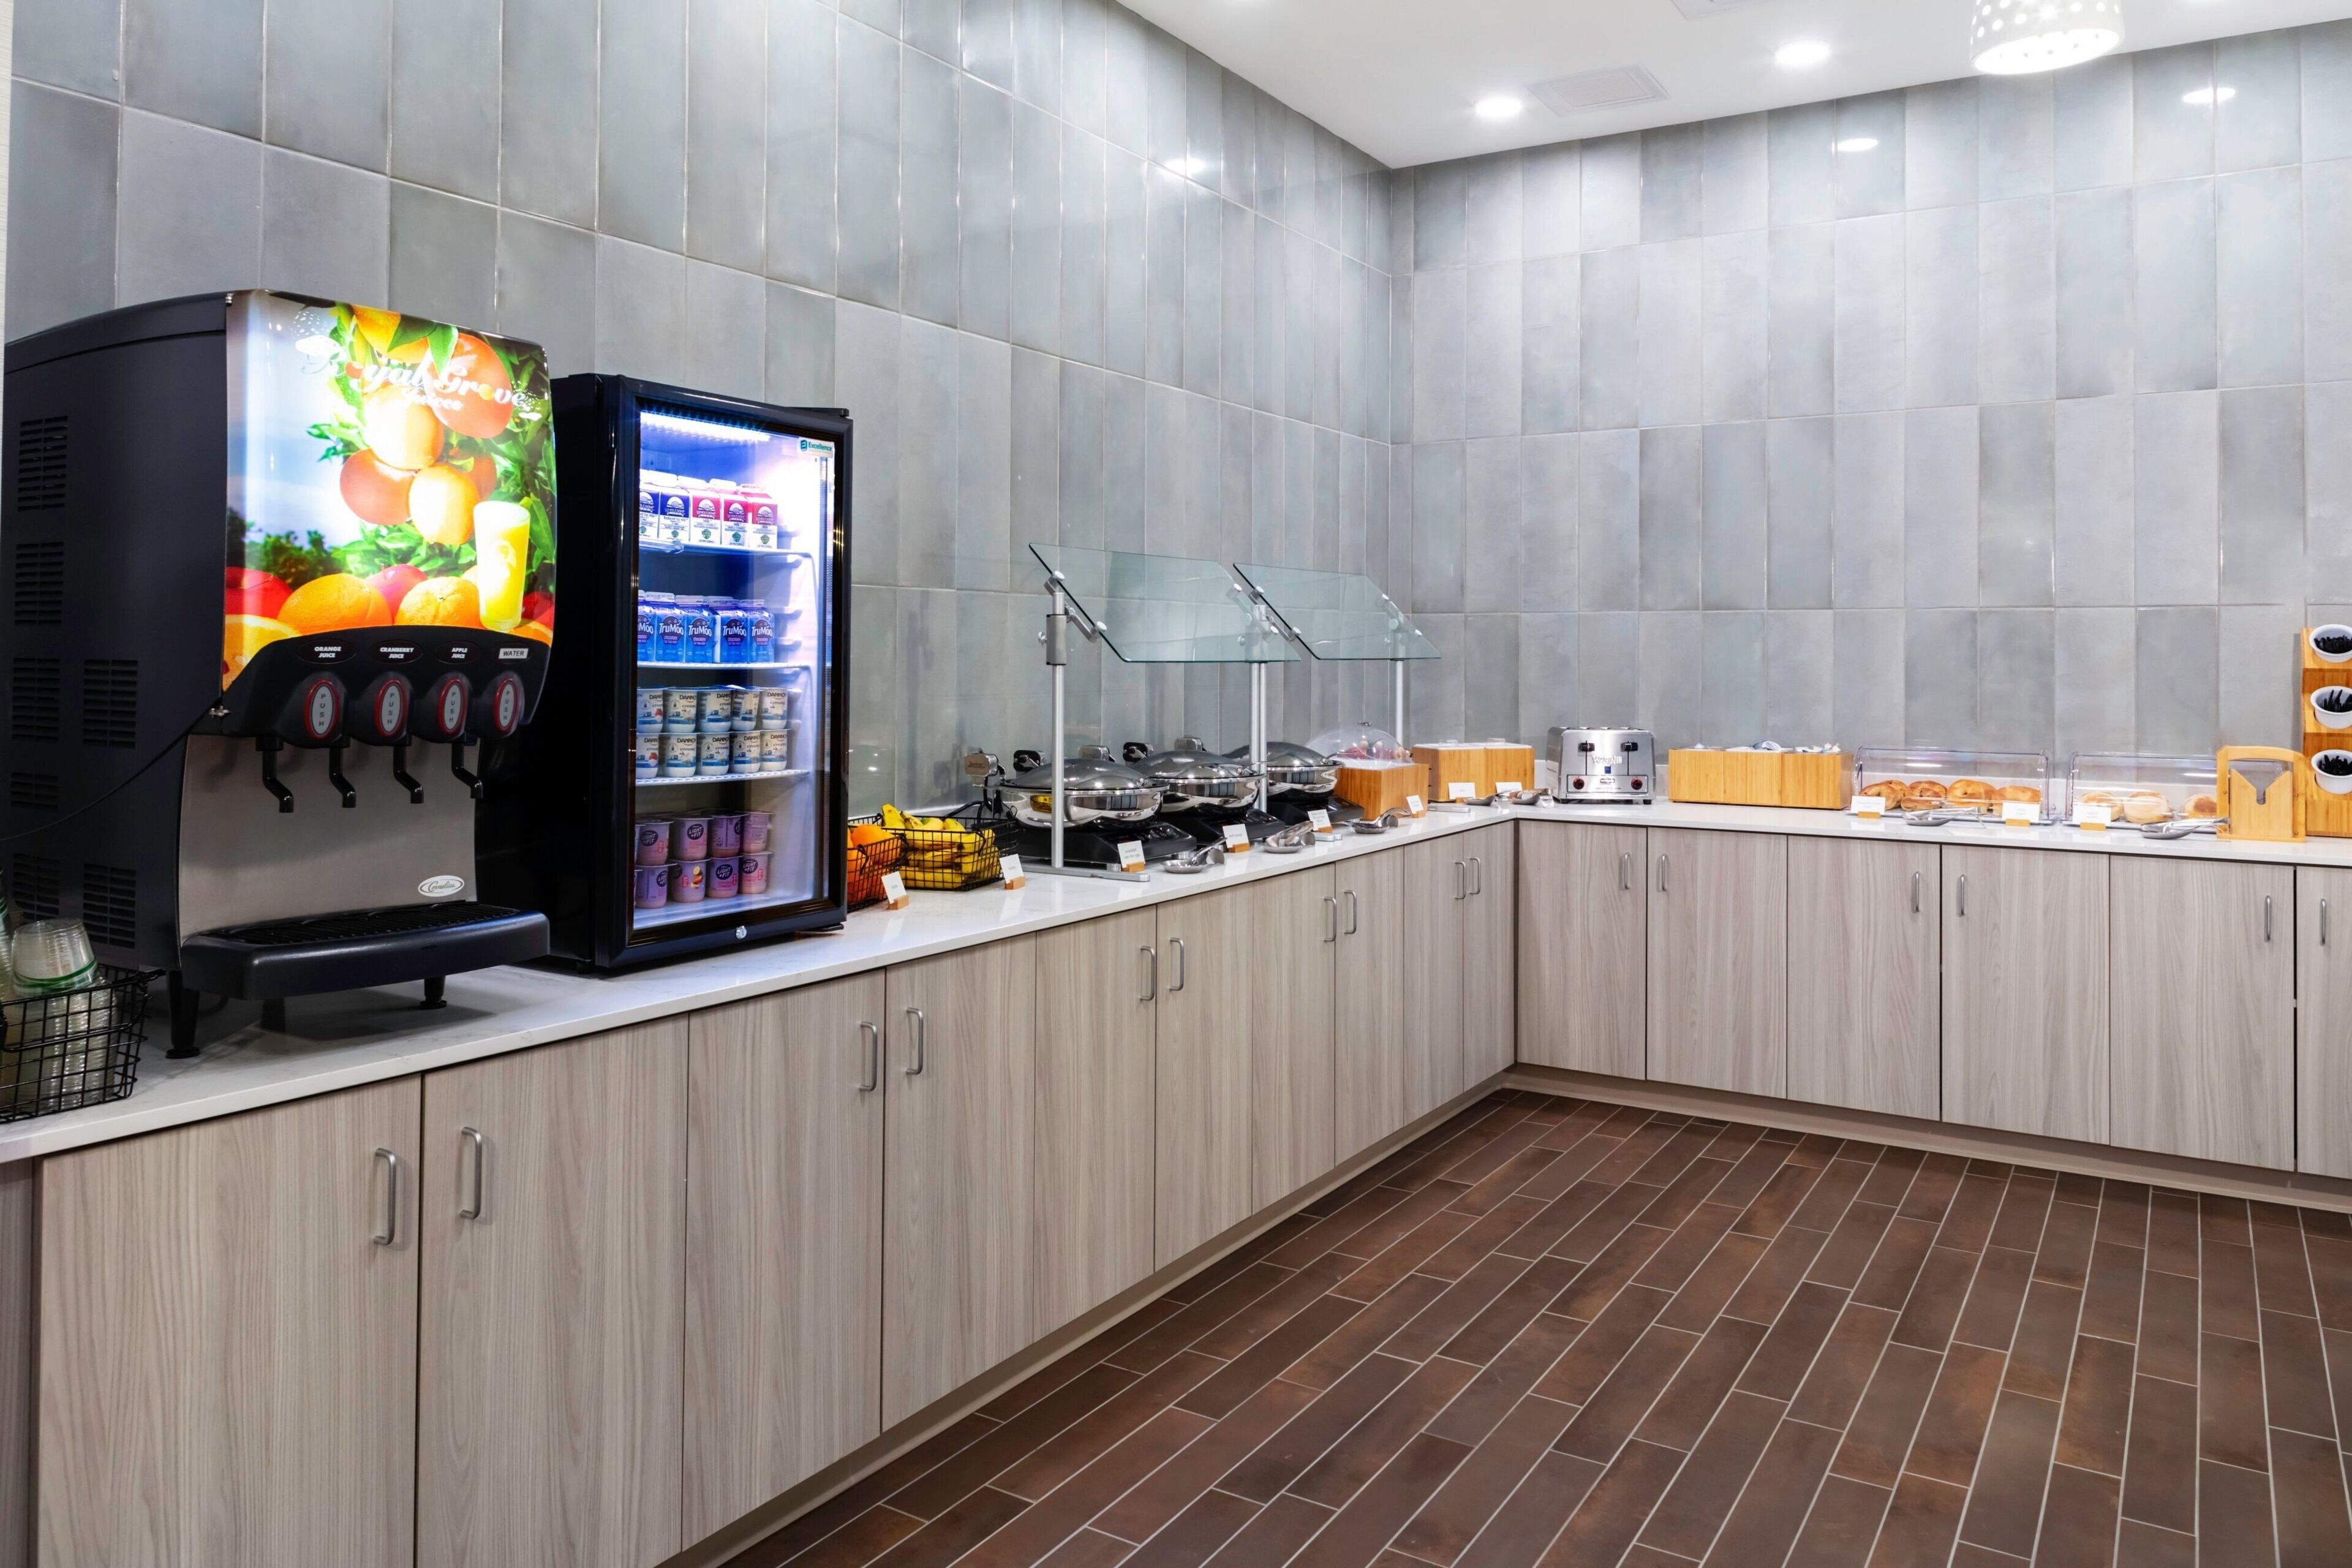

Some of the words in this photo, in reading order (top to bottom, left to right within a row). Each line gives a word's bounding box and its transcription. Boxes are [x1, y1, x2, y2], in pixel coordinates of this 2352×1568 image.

[809, 442, 832, 451] Excellence
[638, 622, 654, 634] Moo
[659, 622, 684, 636] TruMoo
[688, 625, 712, 637] TruMoo
[723, 625, 747, 637] TruMoo
[751, 626, 773, 637] TruMoo
